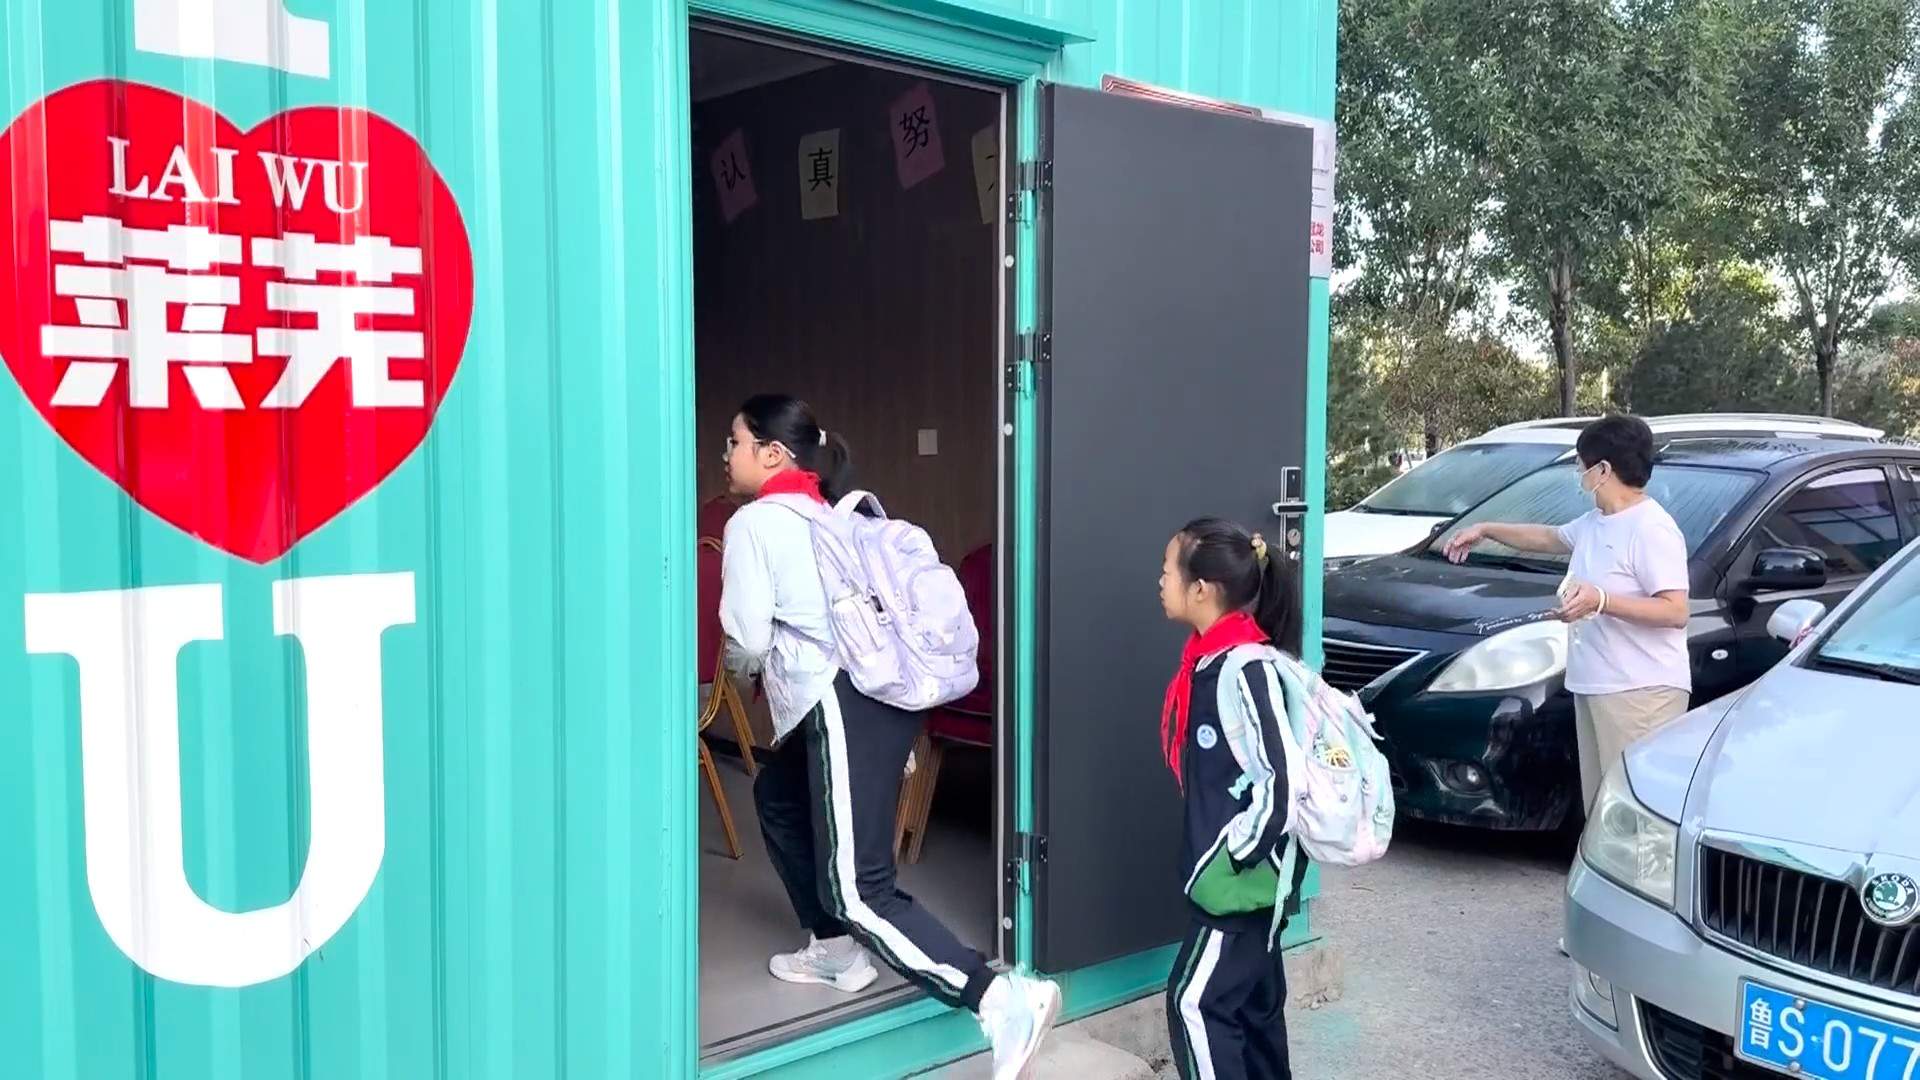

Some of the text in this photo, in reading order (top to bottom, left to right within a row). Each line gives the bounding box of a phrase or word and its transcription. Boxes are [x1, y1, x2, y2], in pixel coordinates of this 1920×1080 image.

[900, 106, 929, 158] 努
[107, 136, 368, 213] LAI WU
[720, 152, 746, 191] 认
[808, 147, 834, 192] 真
[41, 215, 425, 410] 莱芜
[24, 571, 416, 988] U
